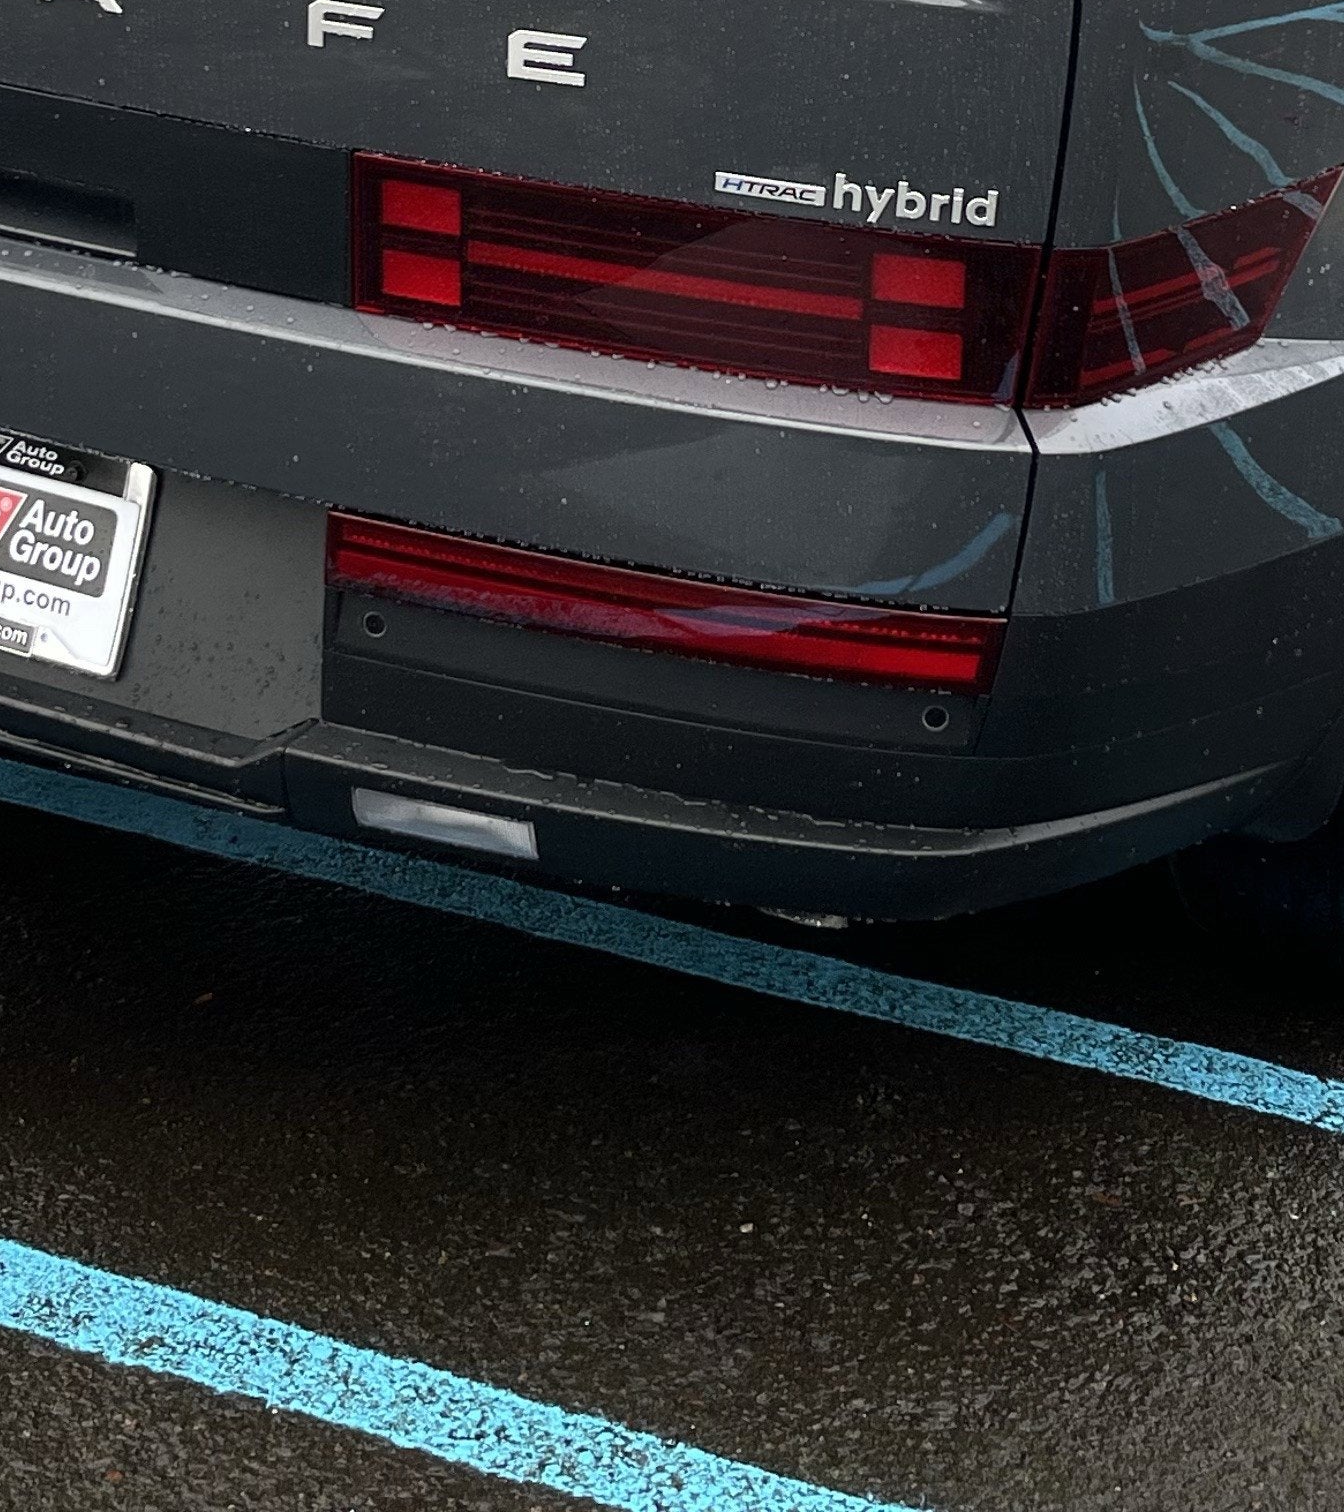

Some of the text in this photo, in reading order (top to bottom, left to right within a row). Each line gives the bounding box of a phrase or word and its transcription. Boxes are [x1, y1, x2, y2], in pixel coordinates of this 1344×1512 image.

[721, 172, 999, 227] HTRAC hybrid
[5, 450, 65, 476] Group
[10, 439, 59, 462] Auto
[19, 498, 96, 546] Auto
[8, 528, 102, 587] Group
